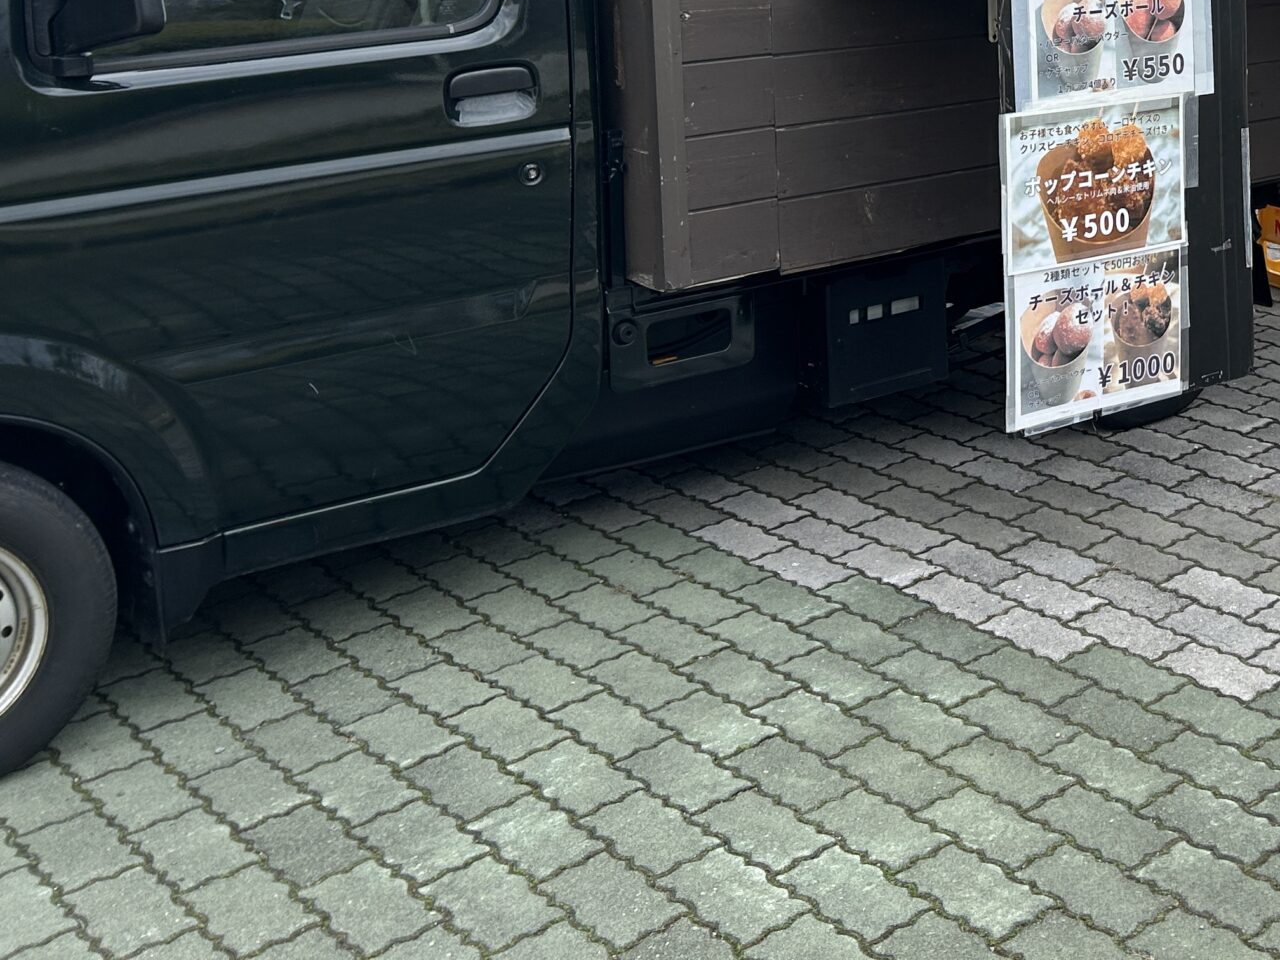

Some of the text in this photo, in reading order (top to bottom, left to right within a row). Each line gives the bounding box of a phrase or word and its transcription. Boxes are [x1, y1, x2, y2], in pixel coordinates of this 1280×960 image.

[1046, 53, 1059, 62] OR
[1025, 158, 1172, 197] ポップコーンチキン
[1059, 207, 1130, 243] ¥500
